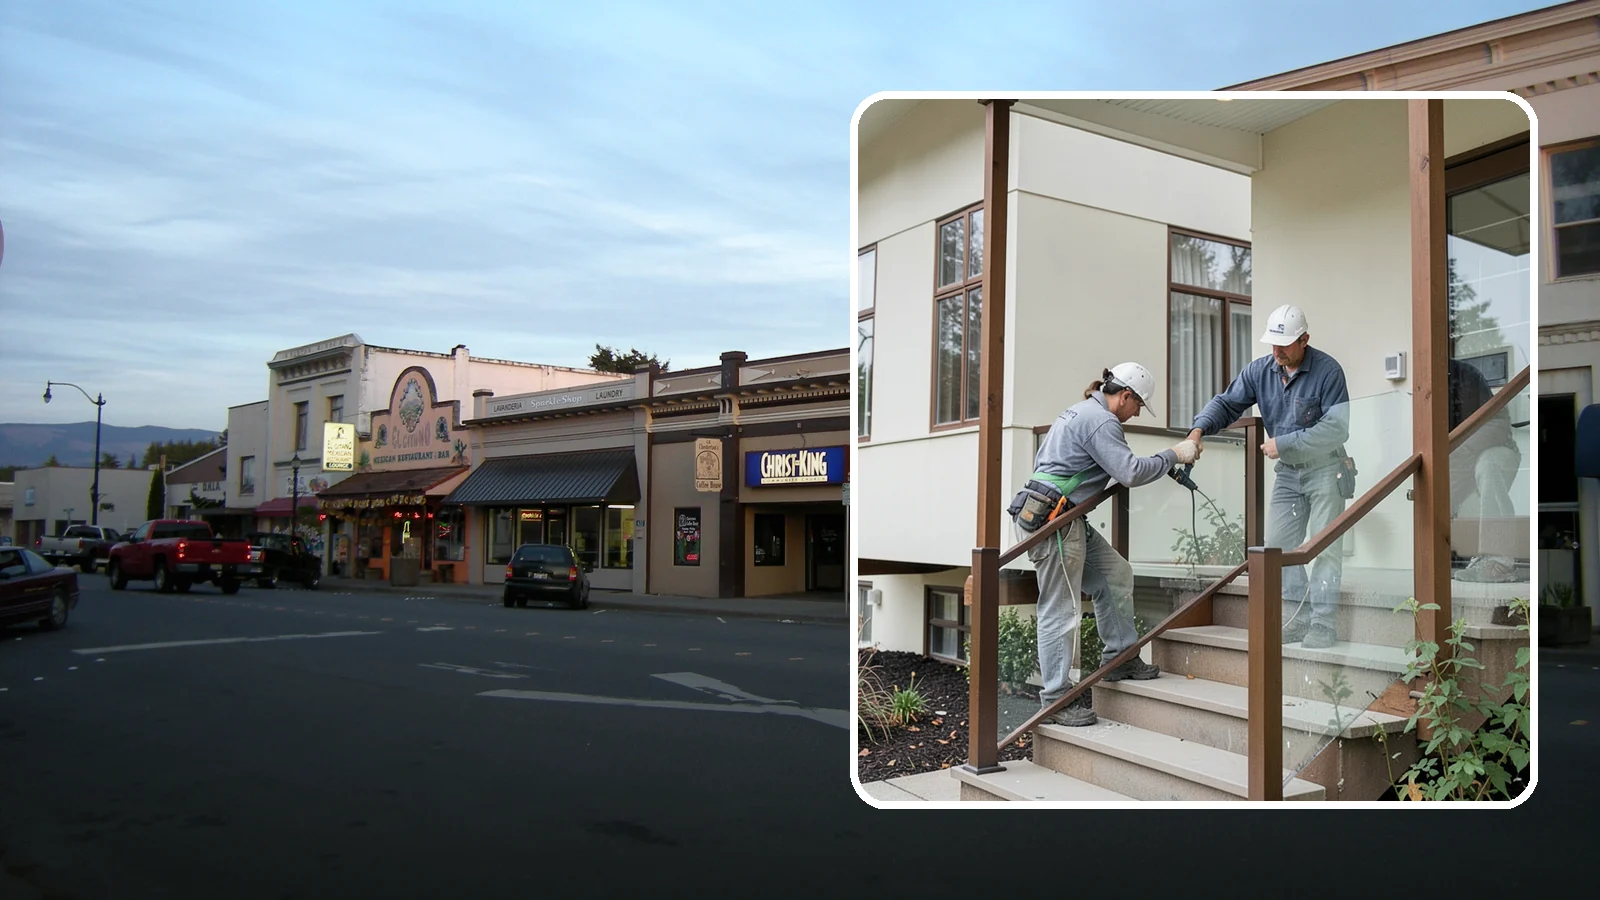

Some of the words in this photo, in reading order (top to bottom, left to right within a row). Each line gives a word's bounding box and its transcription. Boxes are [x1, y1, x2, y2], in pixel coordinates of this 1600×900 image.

[493, 402, 522, 412] LAVANDERIA
[562, 394, 582, 404] Shop
[596, 389, 623, 400] LAUNDRY
[373, 455, 396, 464] MEXICAN
[397, 451, 433, 462] RESTAURANT
[438, 450, 450, 459] BAR
[761, 452, 797, 477] CHRIST
[799, 450, 827, 476] KING
